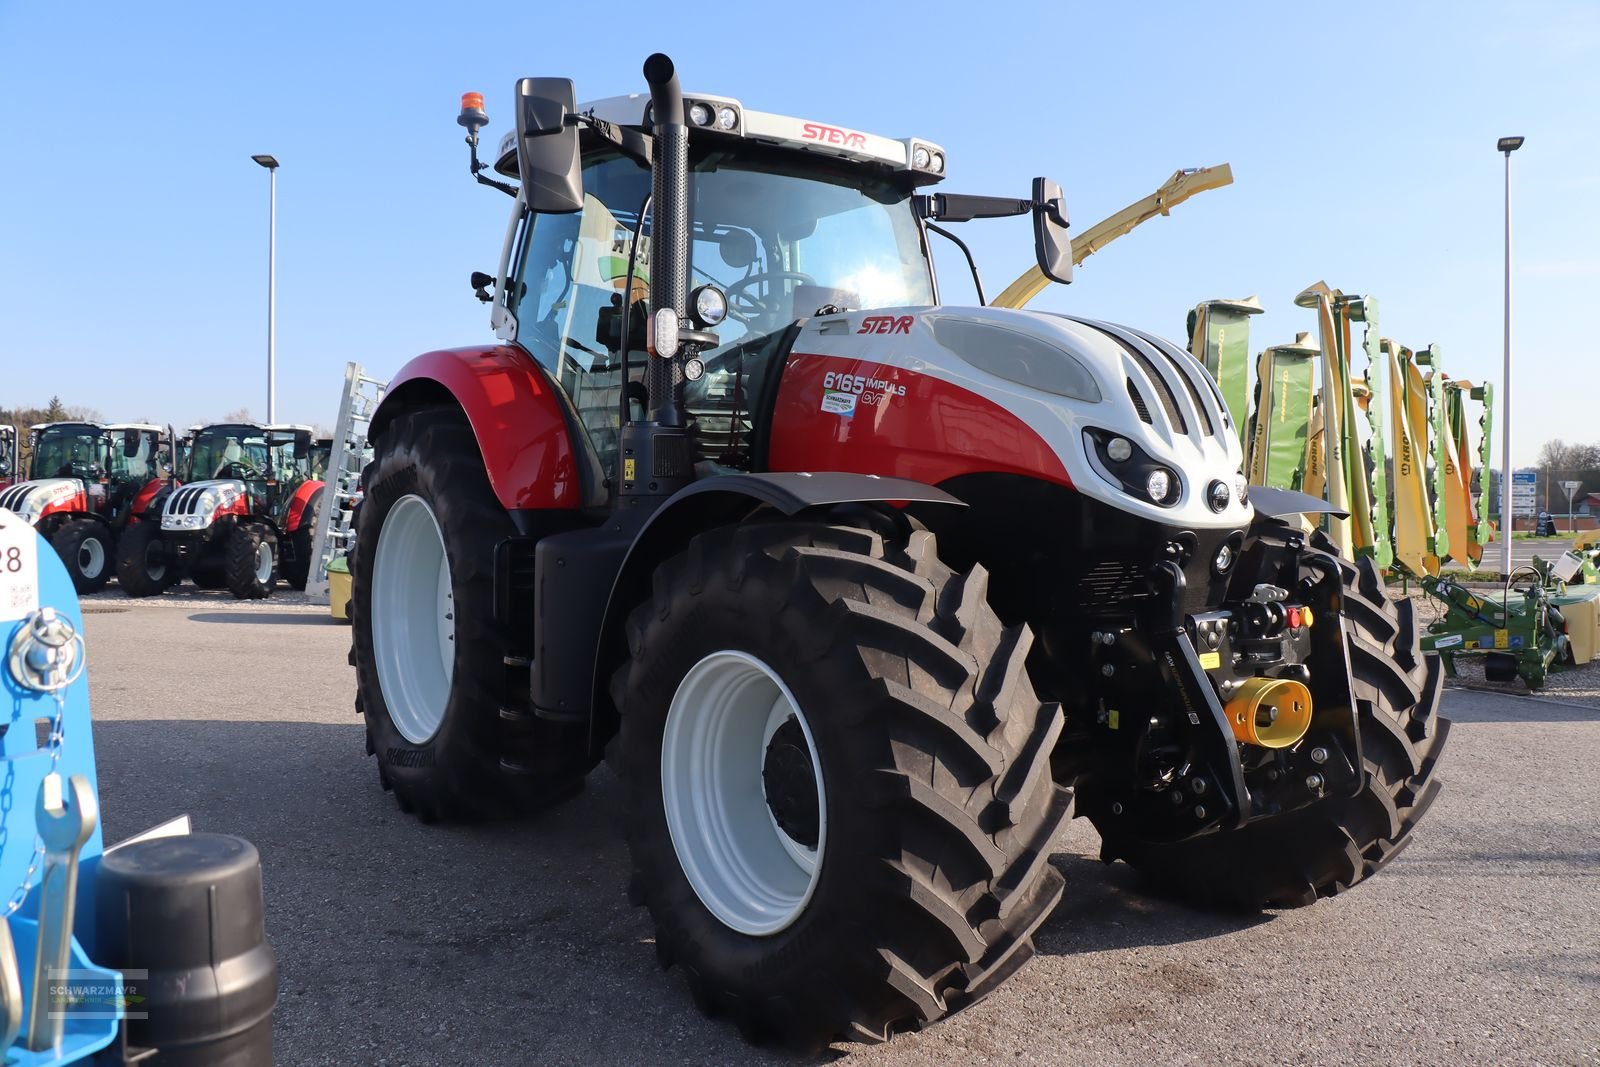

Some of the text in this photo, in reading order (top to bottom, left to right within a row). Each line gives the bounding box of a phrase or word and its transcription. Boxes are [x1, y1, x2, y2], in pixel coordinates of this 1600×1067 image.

[802, 123, 866, 149] STEYR
[857, 315, 914, 334] STEYR
[823, 371, 906, 396] 6165 IMPULS
[861, 390, 887, 407] CVT
[0, 546, 22, 573] 8
